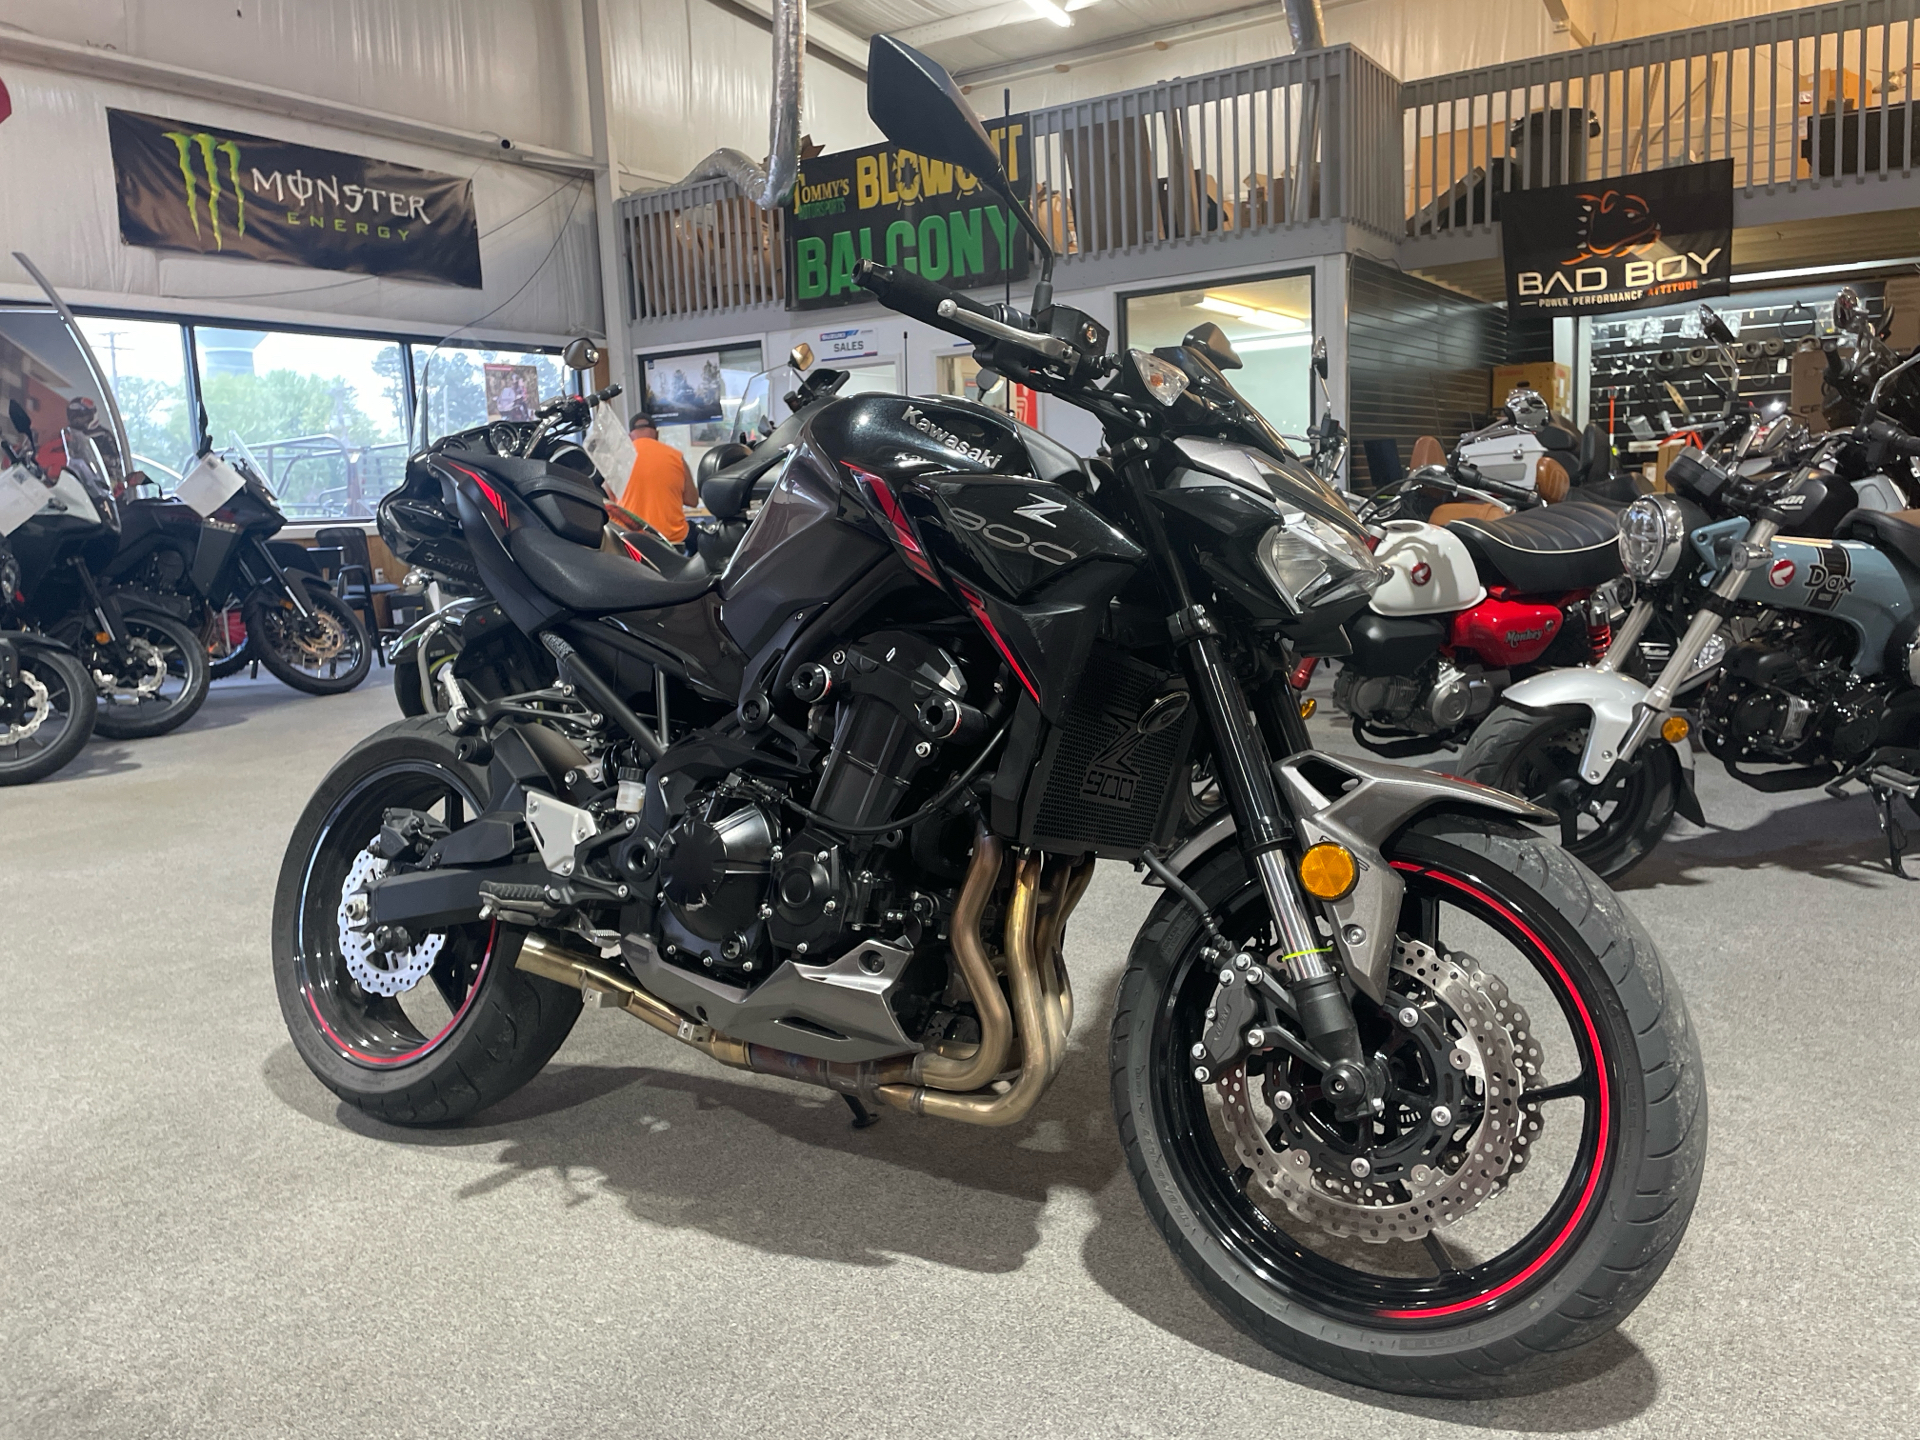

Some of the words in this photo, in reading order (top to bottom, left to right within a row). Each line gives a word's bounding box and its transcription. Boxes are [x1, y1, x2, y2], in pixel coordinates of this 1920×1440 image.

[252, 168, 431, 225] MONSTER
[287, 213, 410, 240] ENERGY
[1518, 267, 1608, 296] BAD
[1625, 248, 1722, 287] BOY
[833, 341, 864, 352] SALES
[901, 405, 1003, 469] Kawasaki
[1804, 564, 1856, 594] Dax
[1506, 629, 1543, 648] Monkey
